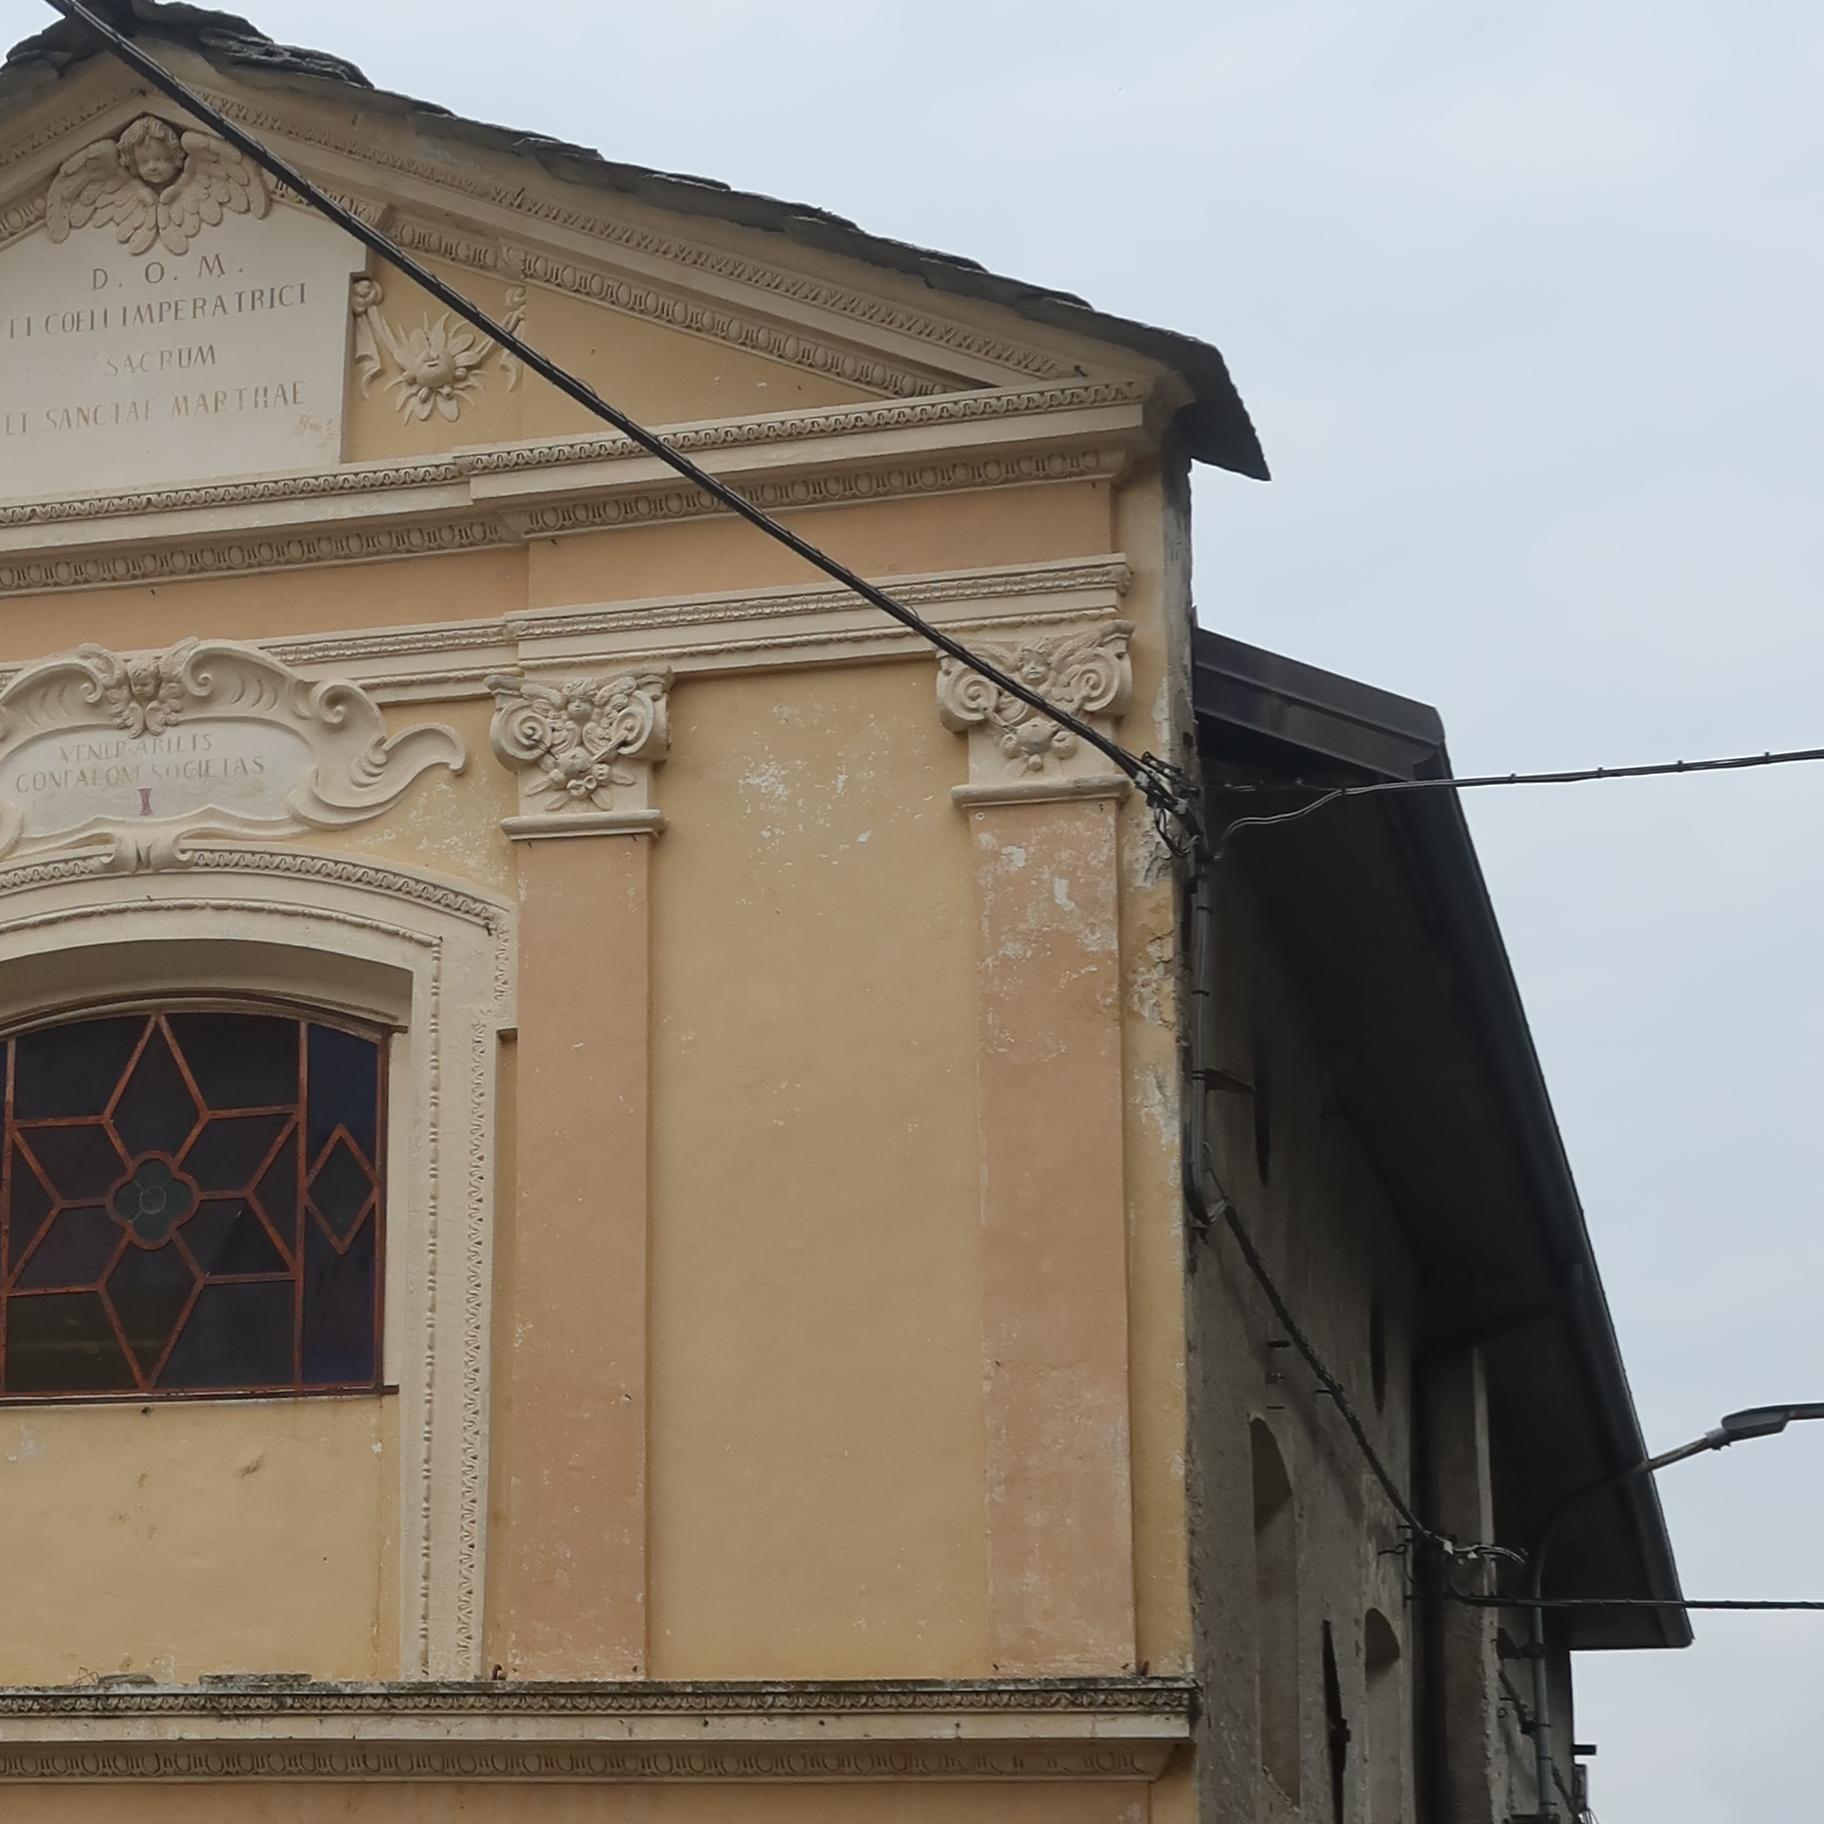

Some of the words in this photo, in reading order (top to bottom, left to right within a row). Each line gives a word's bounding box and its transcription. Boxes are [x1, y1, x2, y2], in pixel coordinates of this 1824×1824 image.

[120, 282, 307, 327] IMPERATRICI
[104, 344, 216, 377] SACRUM
[170, 379, 305, 418] MARTHAE
